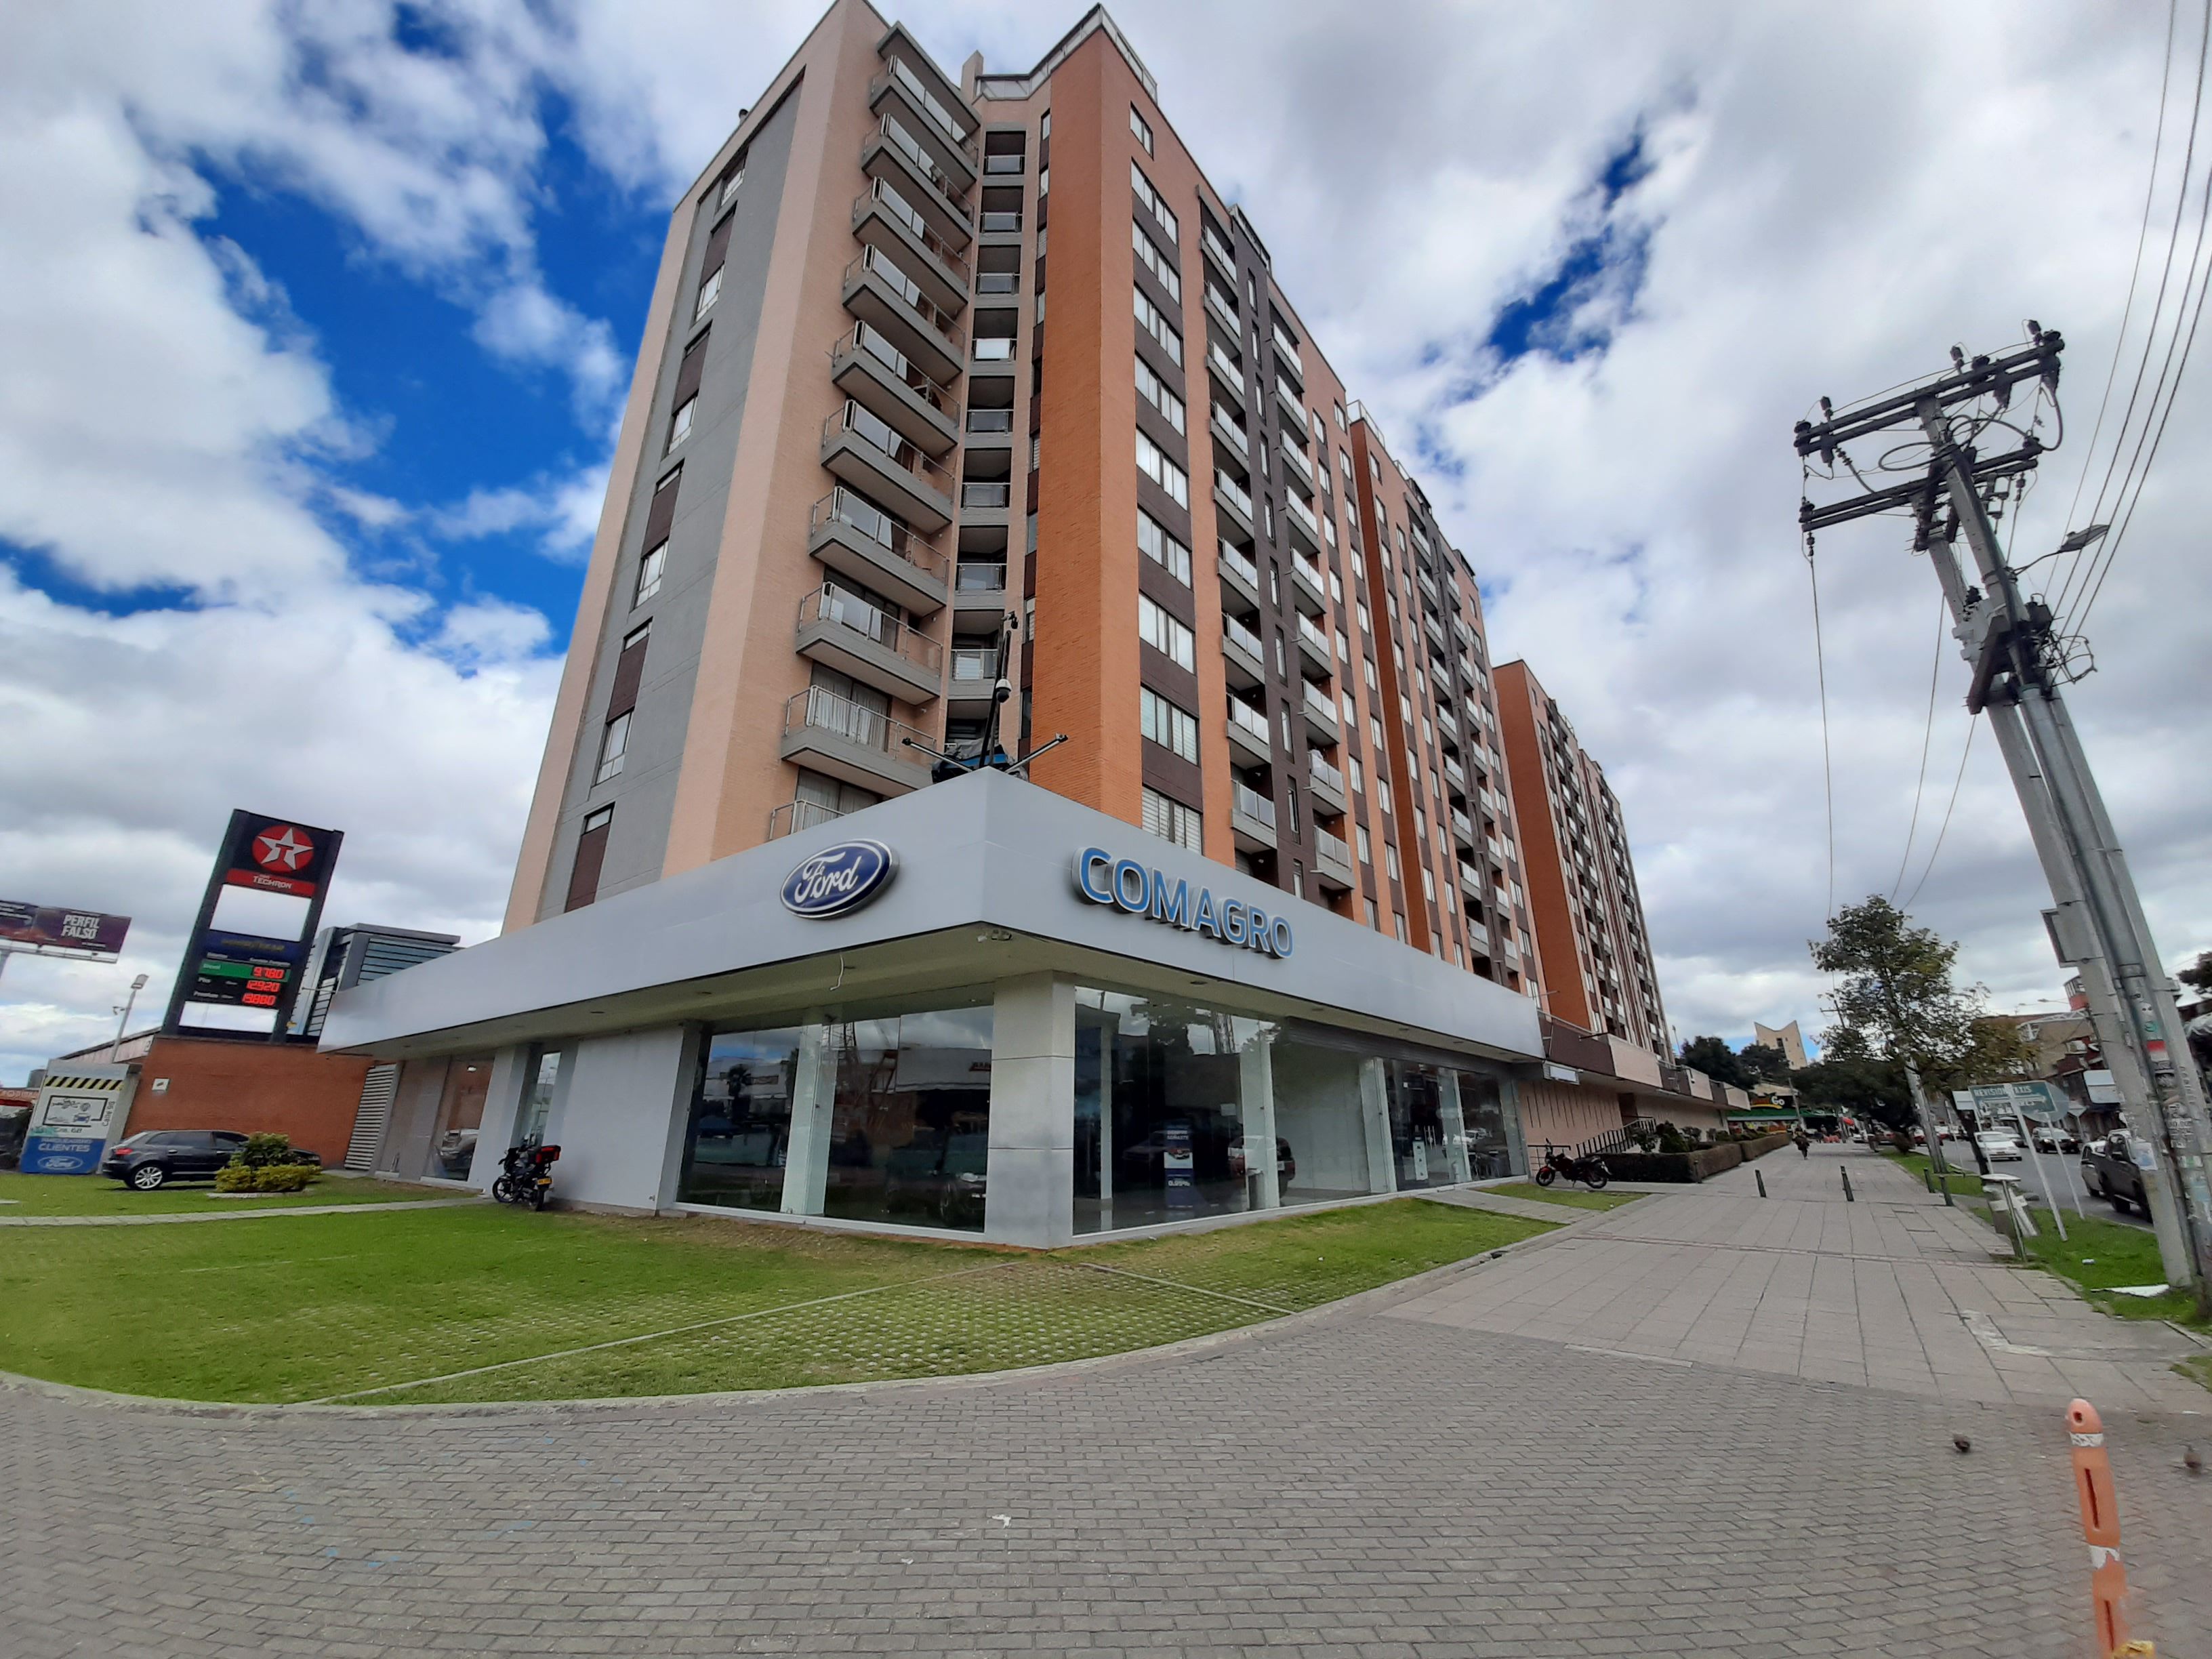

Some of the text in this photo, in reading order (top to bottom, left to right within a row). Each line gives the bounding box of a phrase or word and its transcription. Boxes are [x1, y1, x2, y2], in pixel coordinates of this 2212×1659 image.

[253, 876, 292, 889] TECHRON
[794, 851, 862, 903] Ford
[1079, 846, 1294, 959] COMAGRO
[62, 914, 100, 928] PERFIL
[60, 925, 98, 940] FALSO
[37, 1143, 91, 1153] CLIENTES
